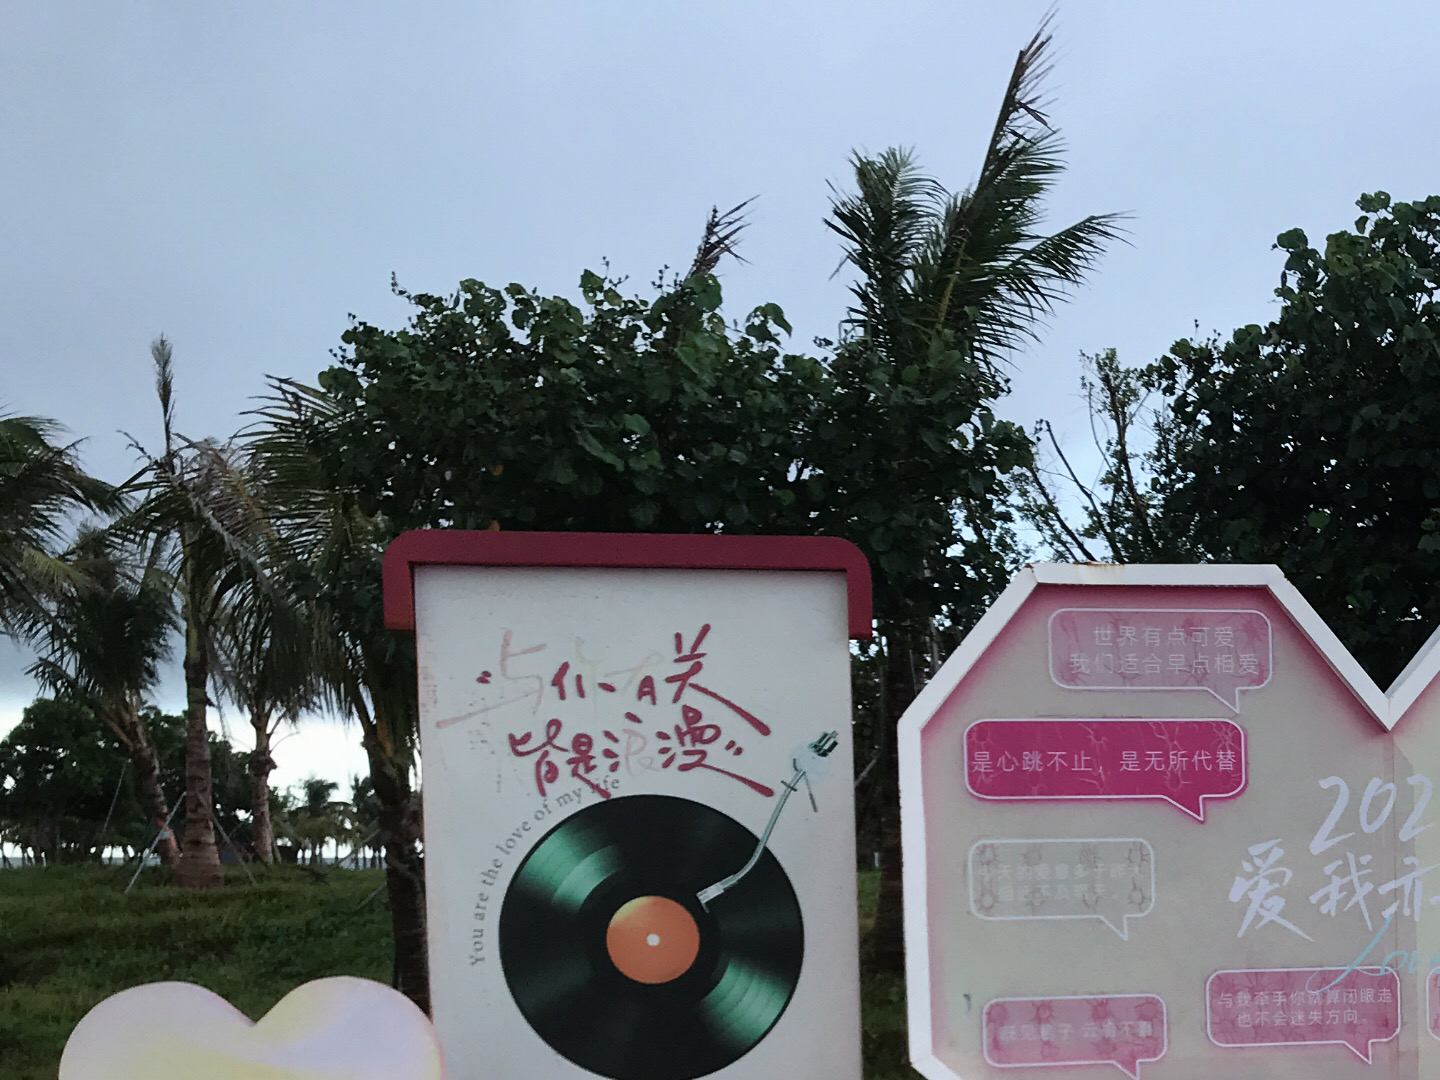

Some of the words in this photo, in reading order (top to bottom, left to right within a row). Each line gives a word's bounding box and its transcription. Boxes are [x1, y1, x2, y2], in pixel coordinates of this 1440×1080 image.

[1093, 626, 1235, 648] 世界有点可爱
[1070, 653, 1259, 675] 我们适合早点相爱
[555, 787, 582, 804] my
[534, 800, 554, 822] of
[495, 820, 532, 856] love
[481, 858, 503, 887] the
[473, 893, 489, 921] are
[470, 928, 485, 967] You
[1218, 988, 1393, 1008] 与我牵手你就算闭眼走
